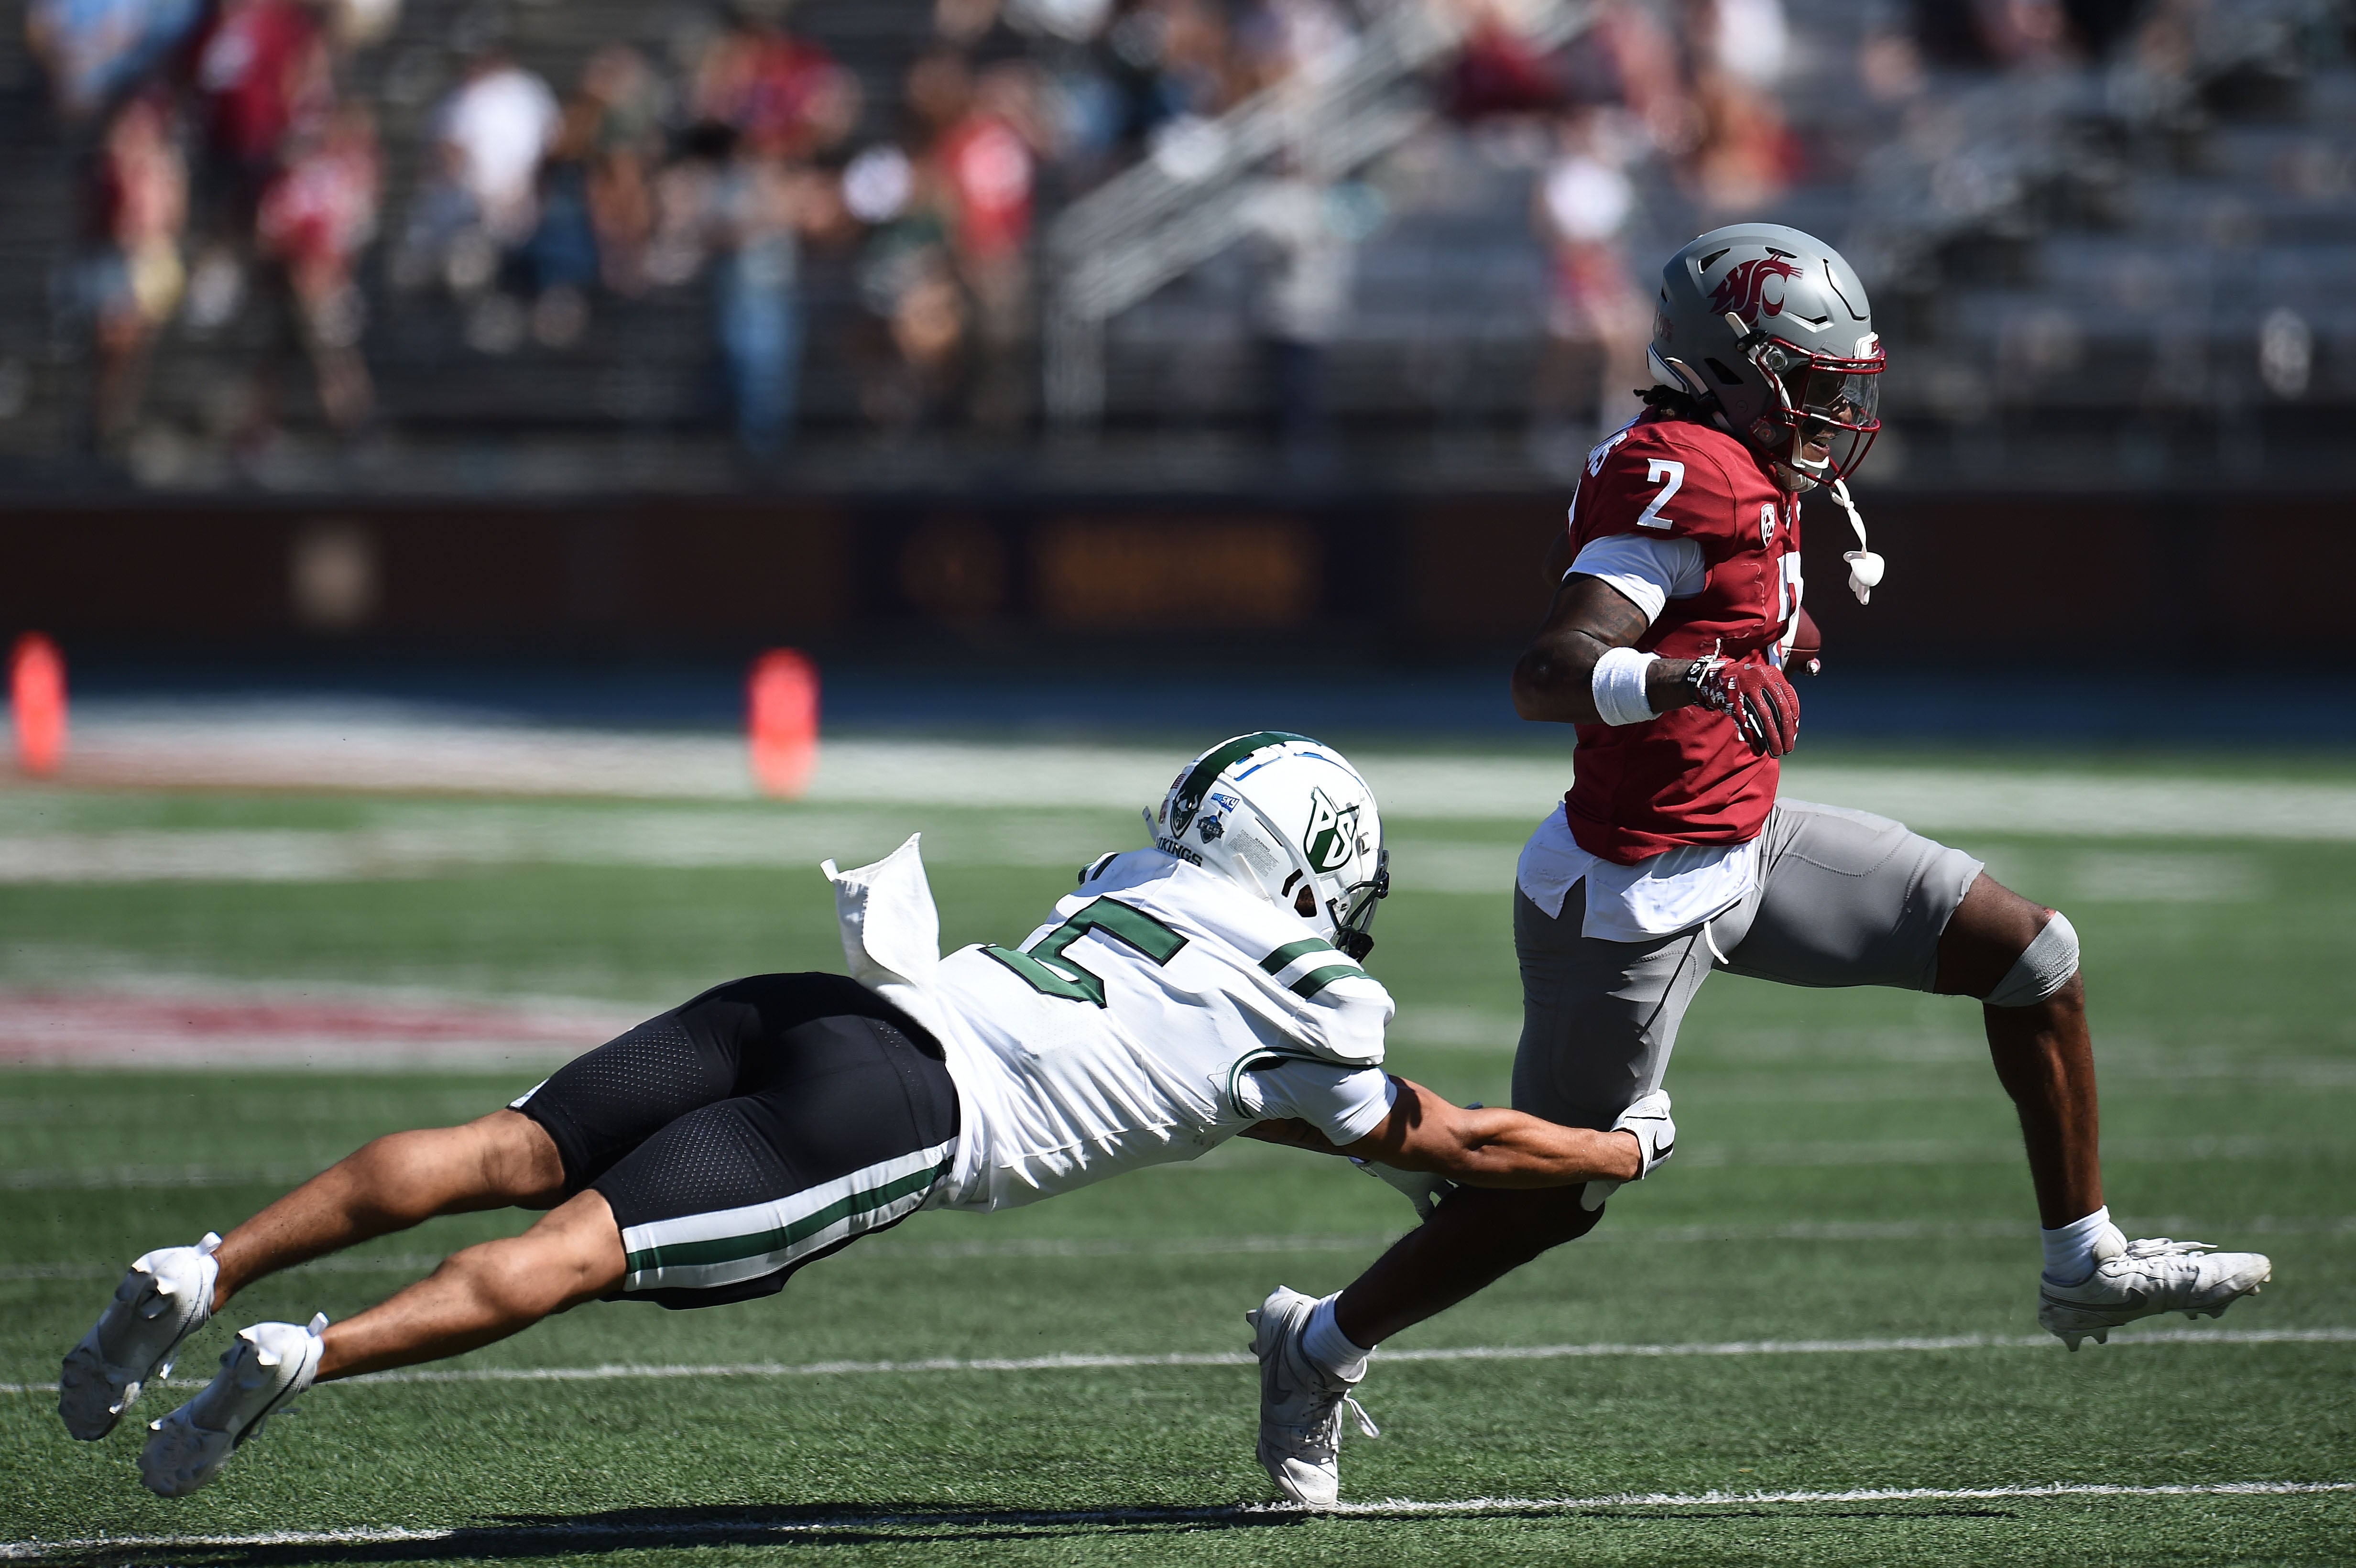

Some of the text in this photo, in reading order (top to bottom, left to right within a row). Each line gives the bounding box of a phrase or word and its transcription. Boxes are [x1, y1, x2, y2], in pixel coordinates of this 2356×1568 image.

[1636, 457, 1685, 530] 2
[1156, 837, 1203, 868] IKINGS
[976, 894, 1190, 1009] 5
